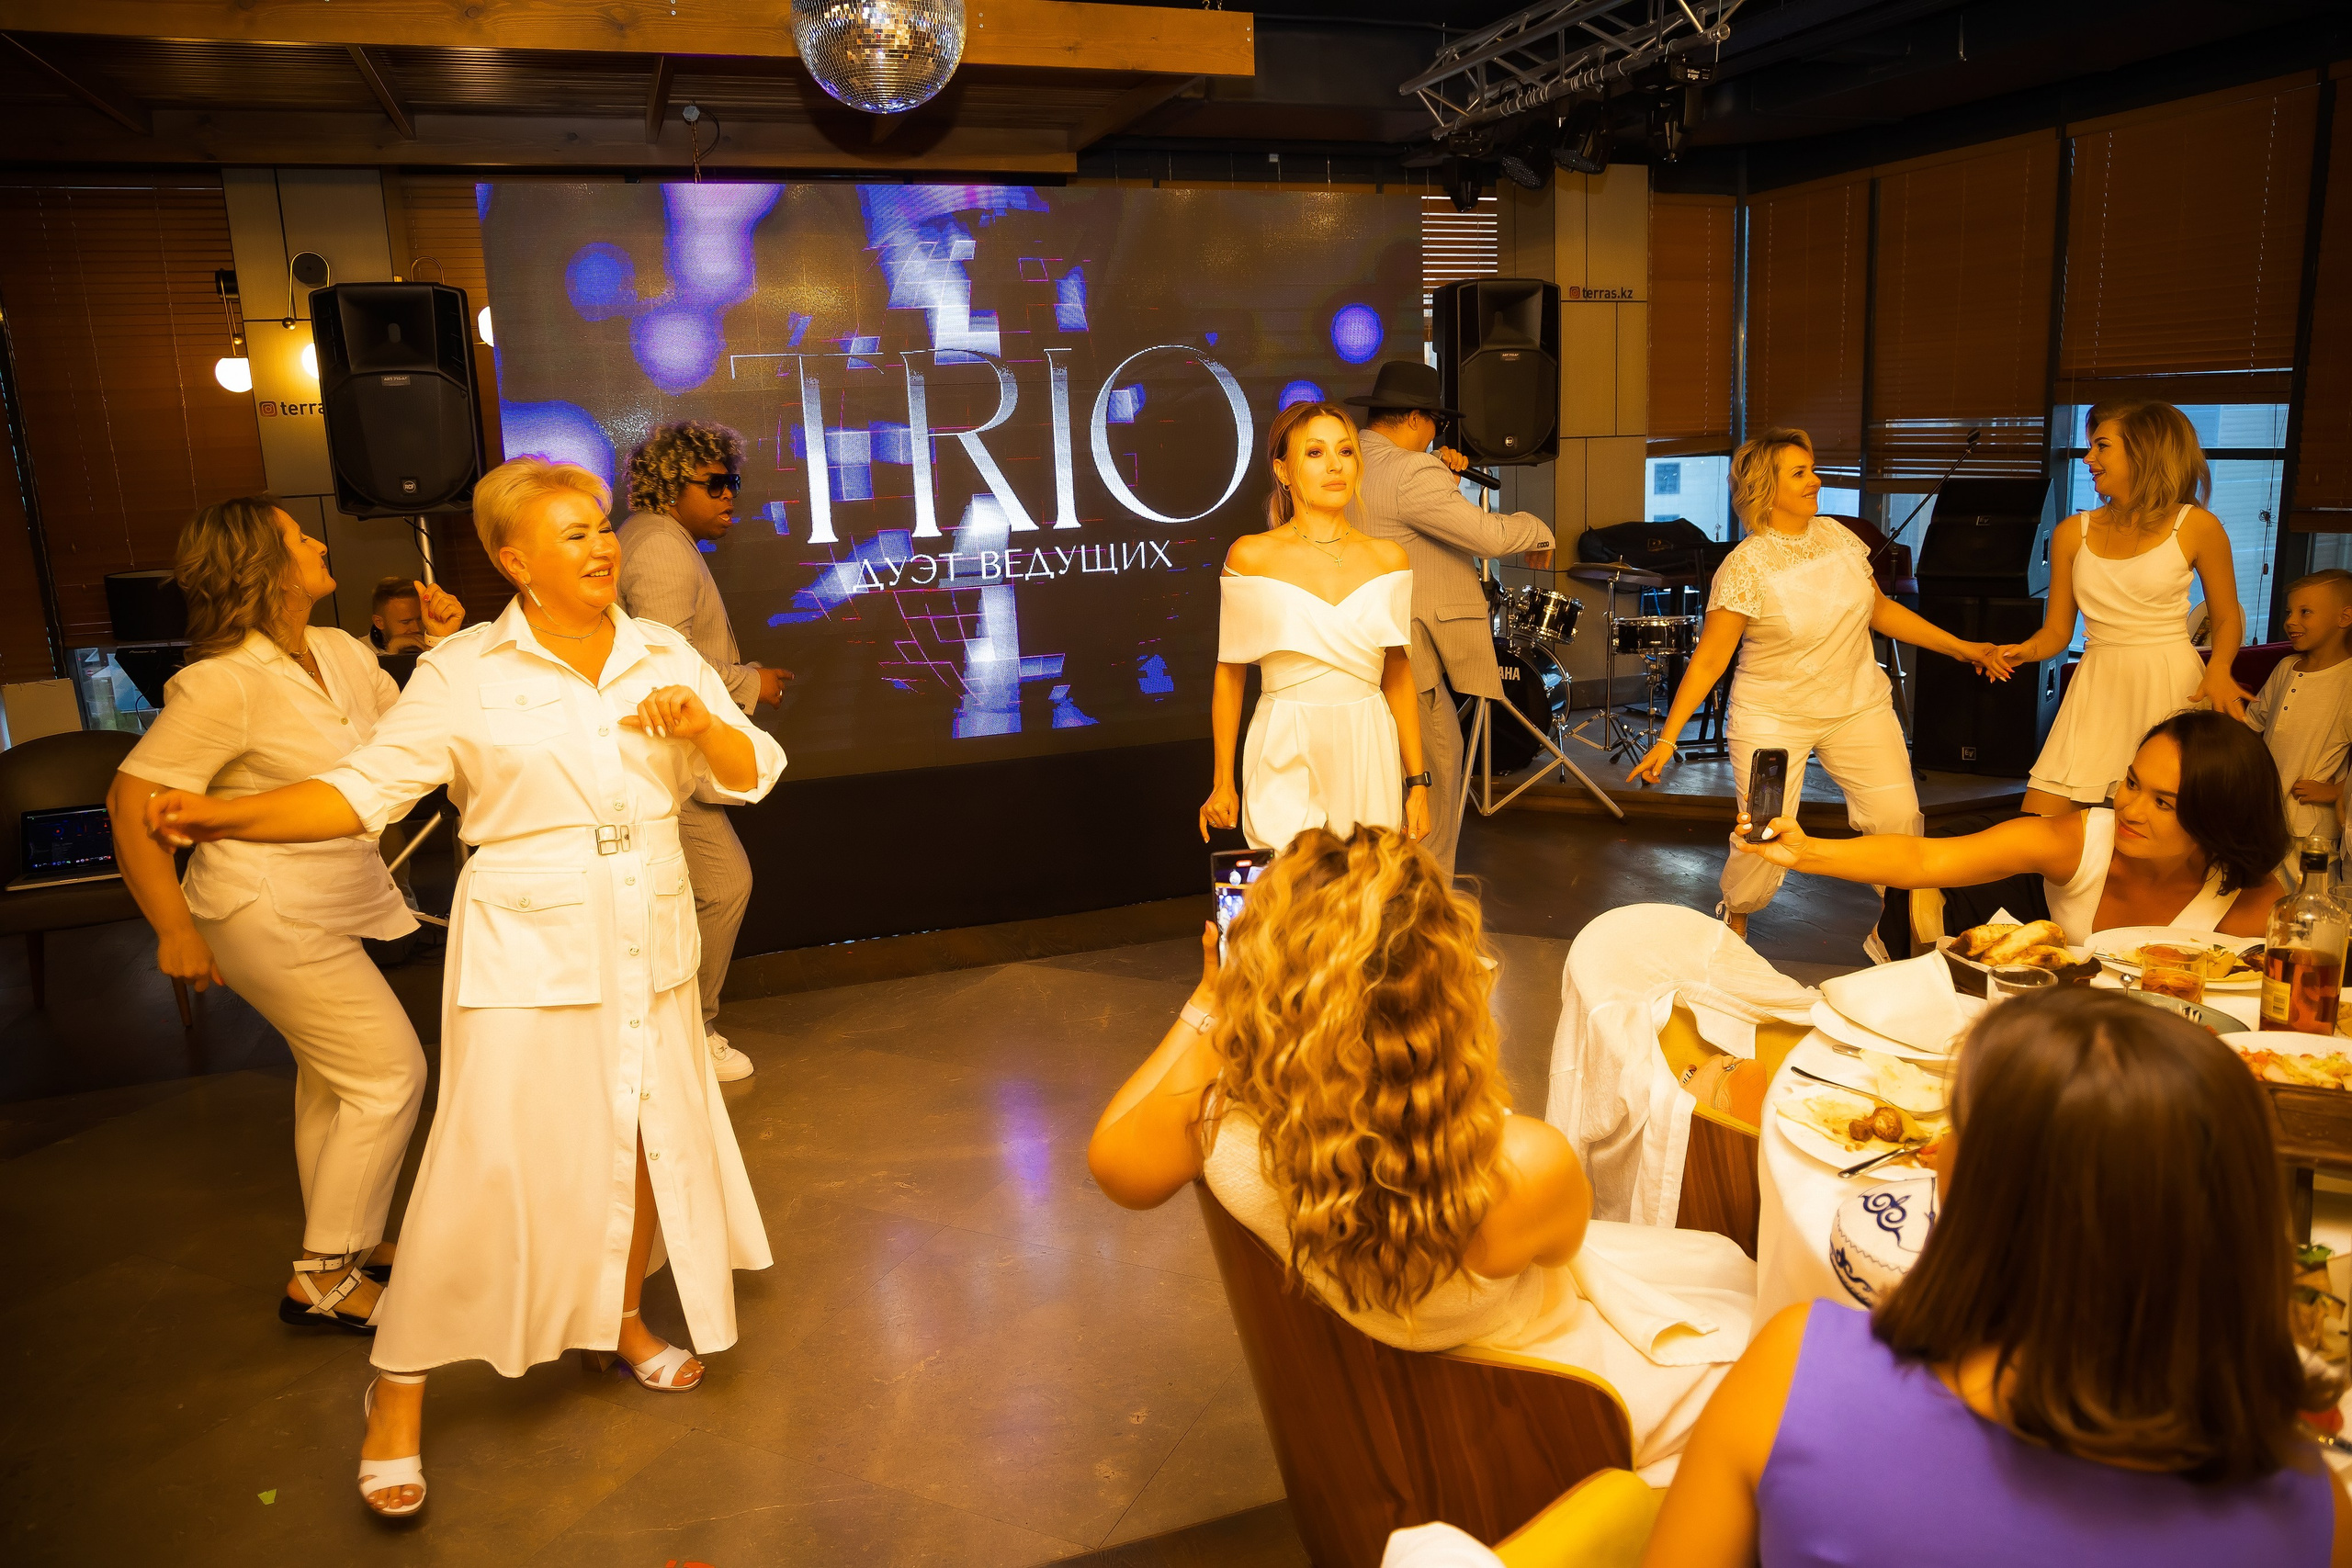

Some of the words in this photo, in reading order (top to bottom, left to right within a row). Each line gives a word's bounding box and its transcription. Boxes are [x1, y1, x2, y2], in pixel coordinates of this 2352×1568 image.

[1582, 286, 1634, 299] terras.kz
[730, 344, 1254, 544] TRIO
[853, 552, 963, 592] ДУЭТ
[979, 540, 1172, 581] ВЕДУЩИХ
